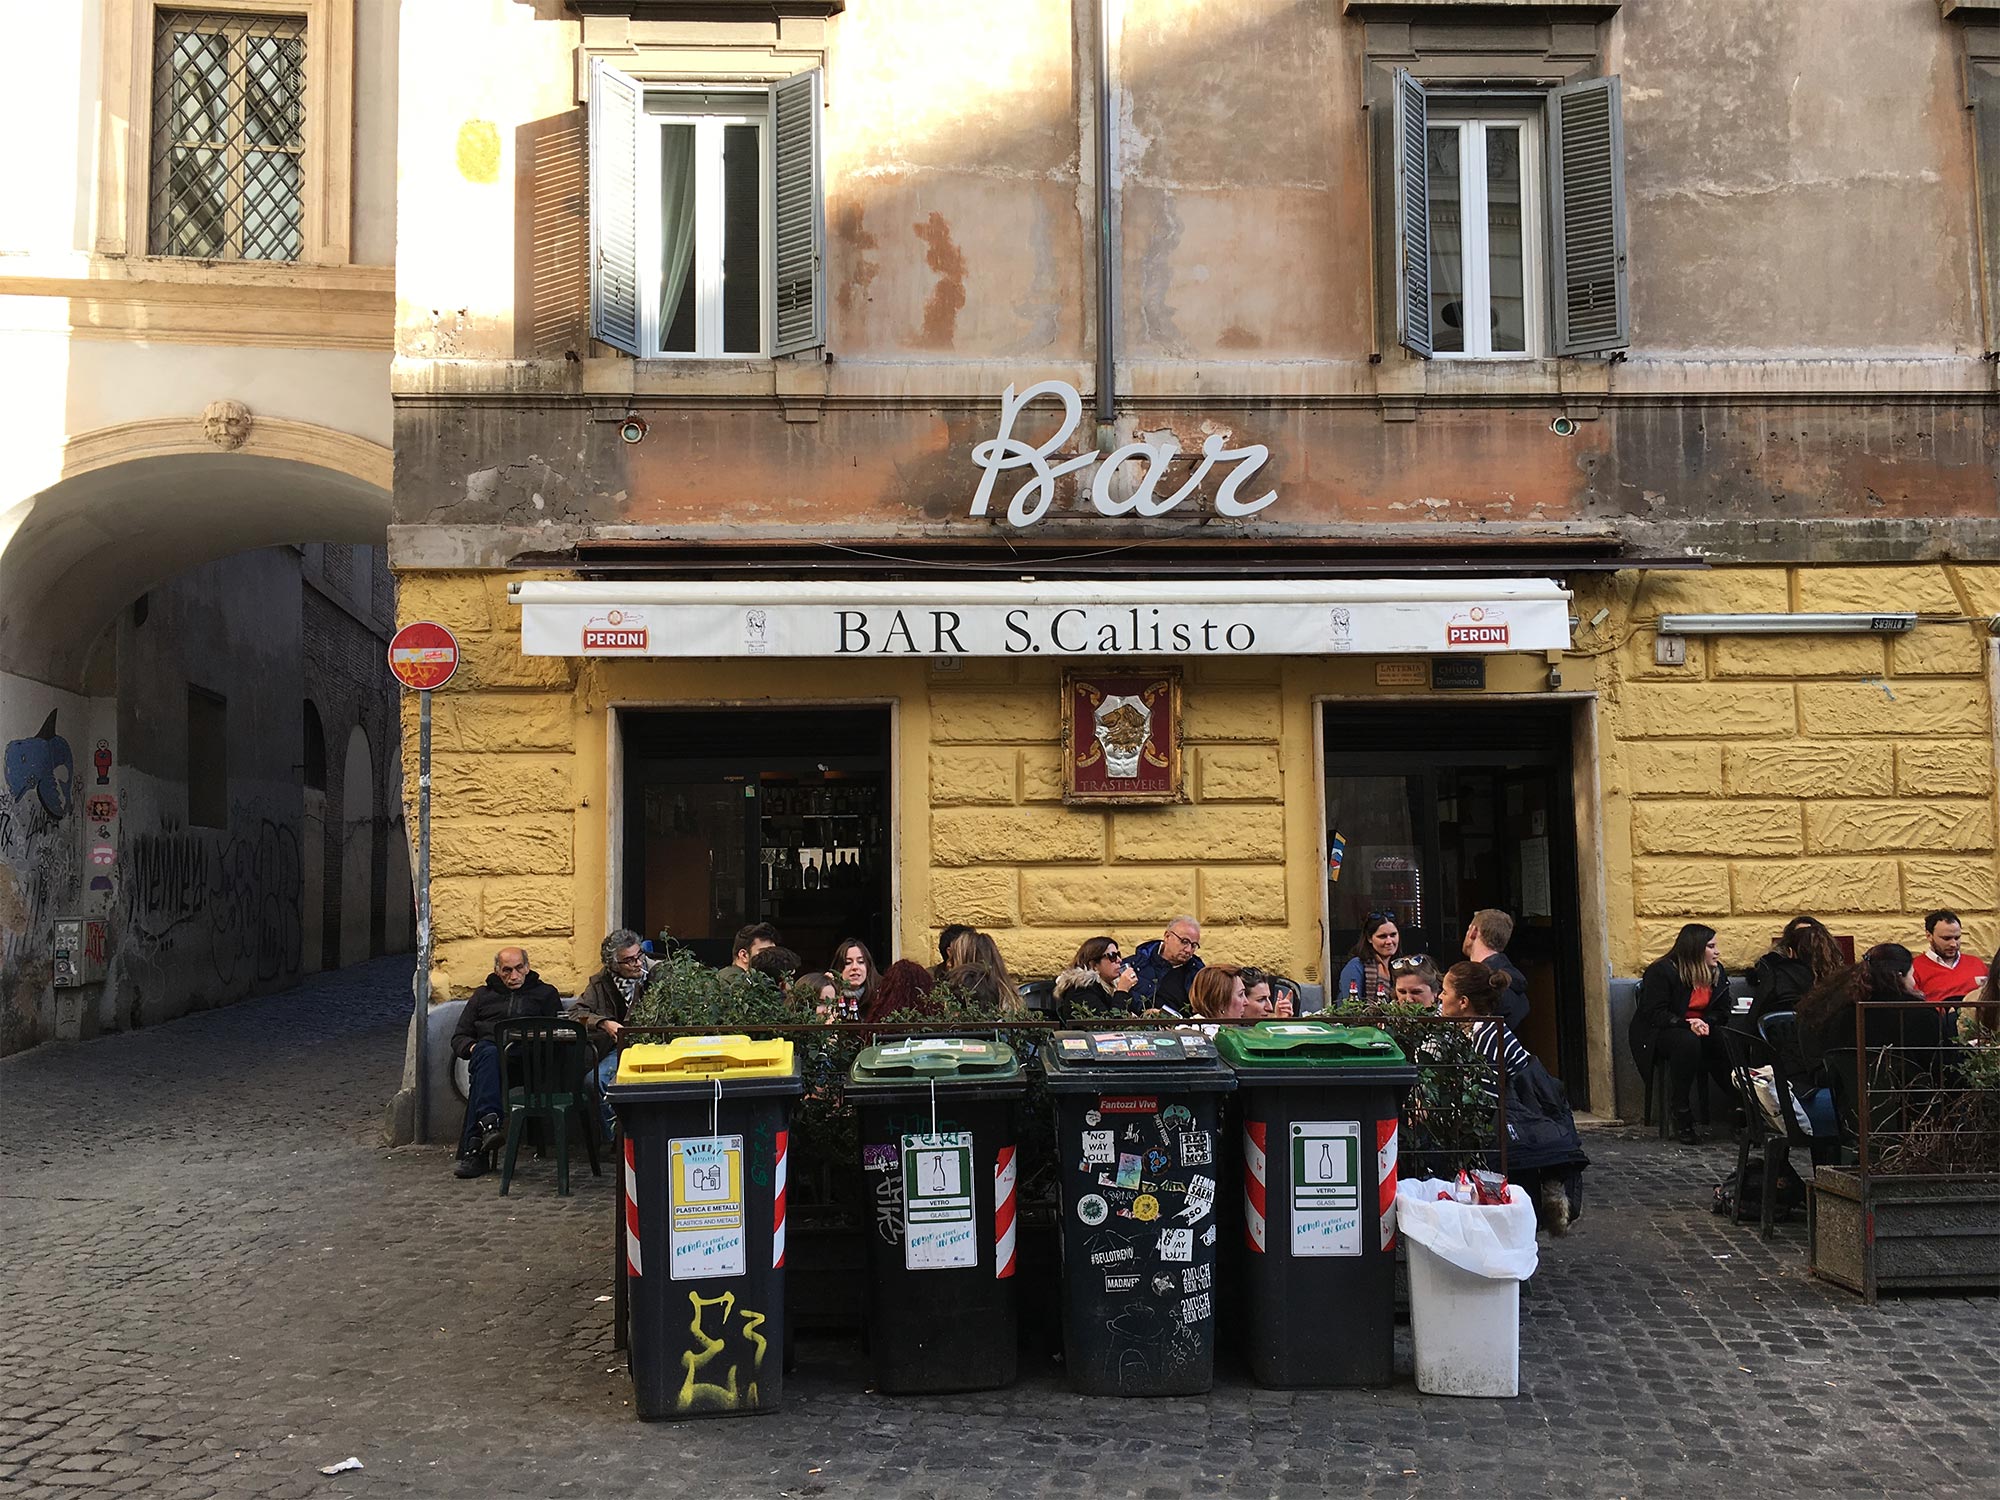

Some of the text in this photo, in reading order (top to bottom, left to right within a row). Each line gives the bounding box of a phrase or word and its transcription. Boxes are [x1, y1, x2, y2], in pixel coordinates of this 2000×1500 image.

[970, 380, 1279, 528] Bar
[834, 609, 1256, 654] BAR S.Calisto
[1451, 629, 1505, 641] PERONI
[587, 633, 644, 646] PERONI
[1665, 640, 1676, 657] 4
[1380, 664, 1421, 673] LATTERIA
[1438, 665, 1477, 674] CHIUSO
[1080, 780, 1166, 791] TRASTEVERE
[1100, 1100, 1137, 1109] Fantozzi
[1184, 1134, 1205, 1144] RED
[1088, 1143, 1108, 1151] WAY
[1087, 1153, 1109, 1161] OUT
[676, 1206, 706, 1214] PLASTICA
[676, 1219, 703, 1227] PLASTICS
[1181, 1262, 1211, 1282] 2MUCH
[1180, 1292, 1211, 1313] 2MUCH
